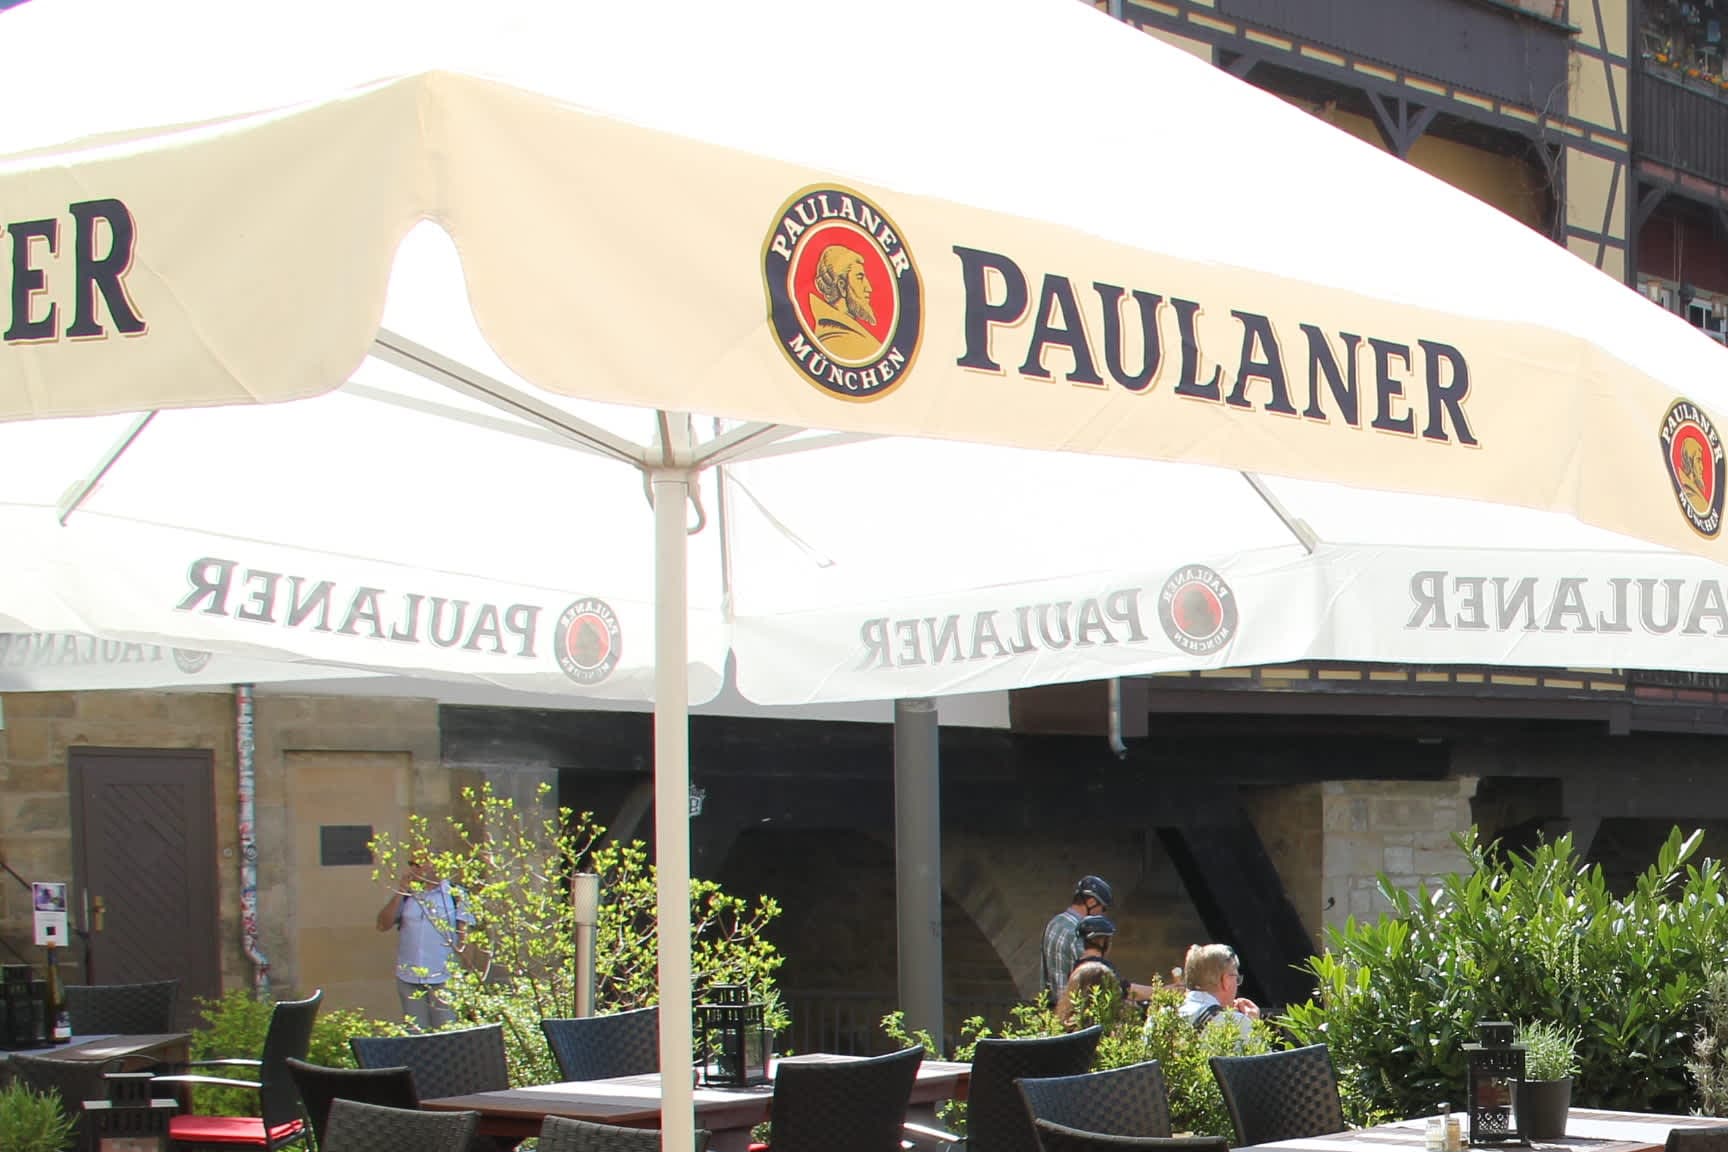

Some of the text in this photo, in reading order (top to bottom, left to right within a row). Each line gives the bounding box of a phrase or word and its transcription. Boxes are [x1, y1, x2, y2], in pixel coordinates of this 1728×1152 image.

[0, 198, 149, 345] ER
[771, 194, 911, 278] PAULANER
[788, 333, 906, 391] MÜNCHEN
[953, 245, 1481, 448] PAULANER
[1661, 403, 1724, 464] PAULANER
